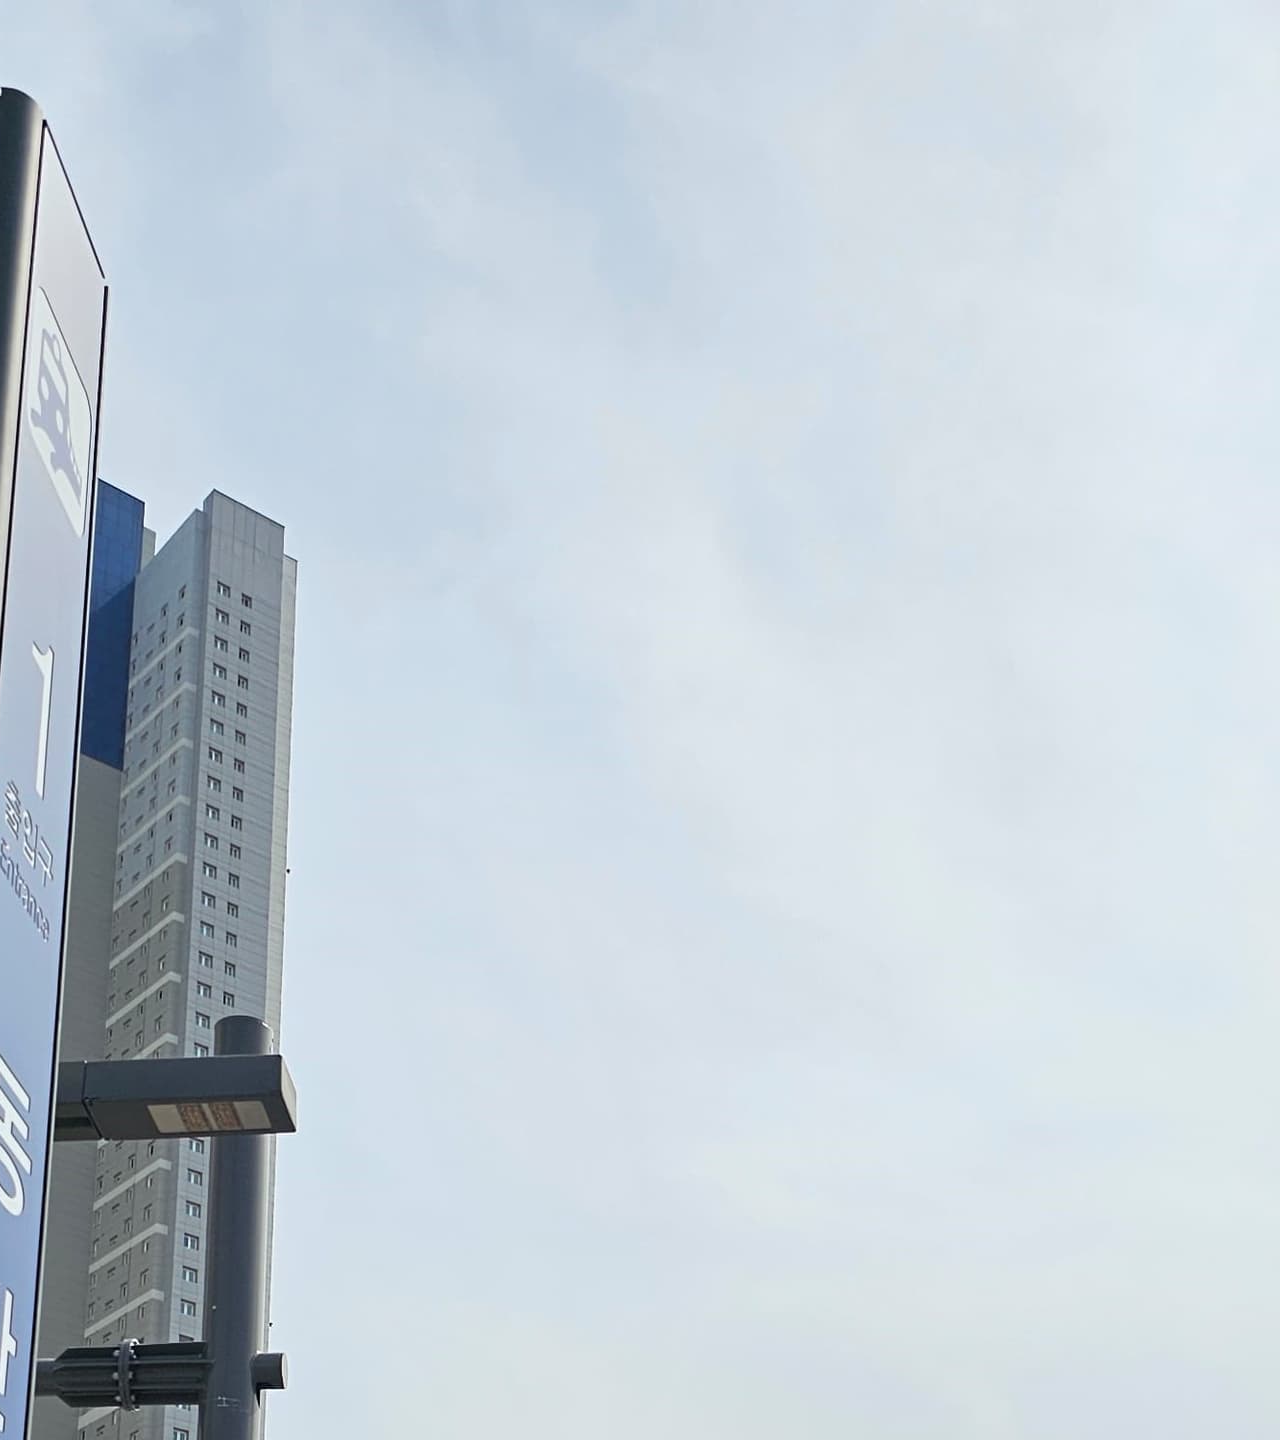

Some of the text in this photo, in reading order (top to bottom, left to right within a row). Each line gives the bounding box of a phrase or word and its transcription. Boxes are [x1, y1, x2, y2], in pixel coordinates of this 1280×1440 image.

[31, 640, 55, 801] 1
[4, 779, 55, 887] 출입구
[0, 837, 50, 943] Entrance
